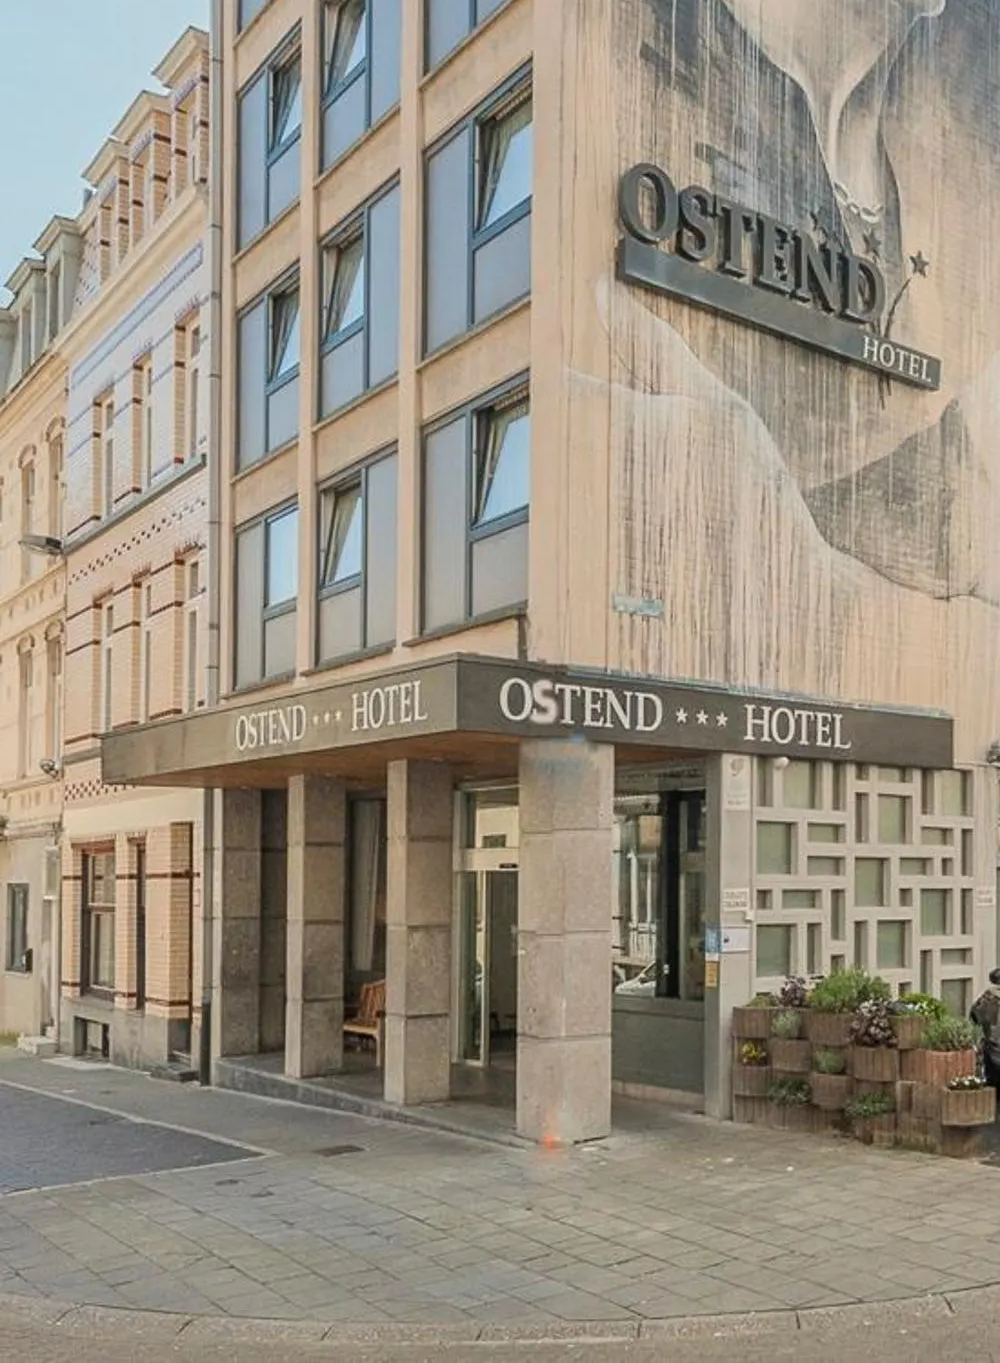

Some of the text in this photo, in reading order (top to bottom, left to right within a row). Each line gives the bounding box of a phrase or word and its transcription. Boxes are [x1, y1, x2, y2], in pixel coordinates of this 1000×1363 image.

[619, 162, 886, 324] OSTEND
[863, 335, 932, 383] HOTEL
[235, 679, 428, 751] OSTEND HOTEL
[499, 677, 852, 750] OSTEND HOTEL
